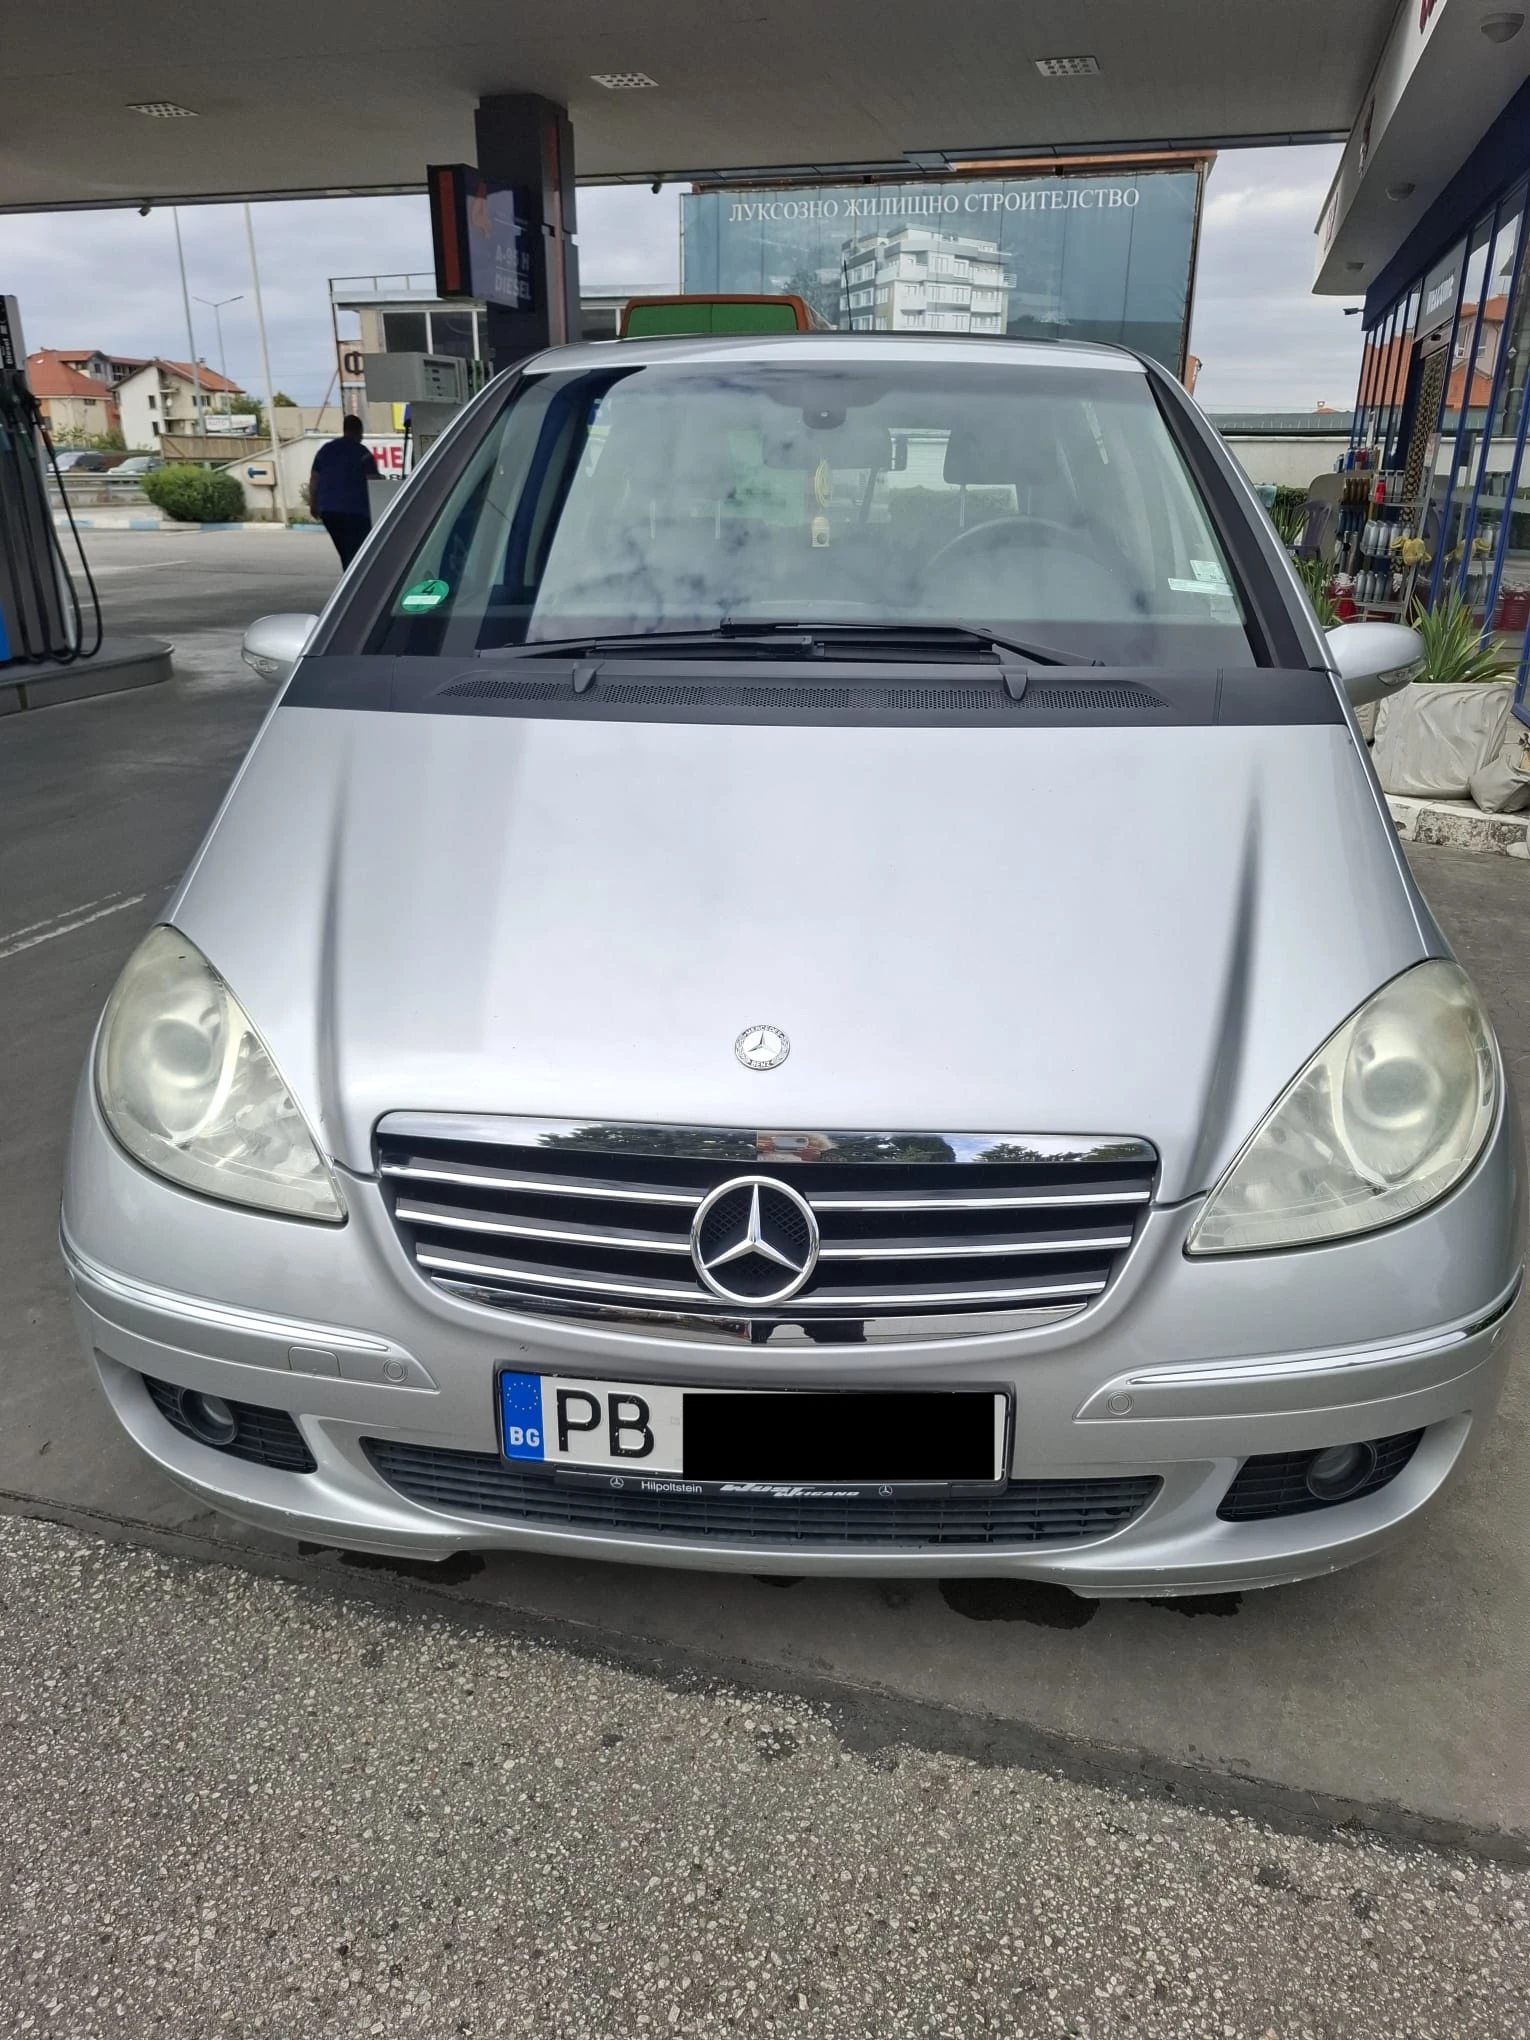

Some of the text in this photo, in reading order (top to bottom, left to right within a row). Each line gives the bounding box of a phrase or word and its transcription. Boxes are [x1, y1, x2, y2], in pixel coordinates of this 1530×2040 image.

[729, 188, 1140, 222] ЛУКСОЗНО ЖИЛИЩНО СТРОИТЕЛСТВО
[495, 273, 531, 300] DIESEL
[556, 1387, 656, 1459] PB
[510, 1426, 540, 1448] BG
[641, 1480, 703, 1494] Hilpoltstein
